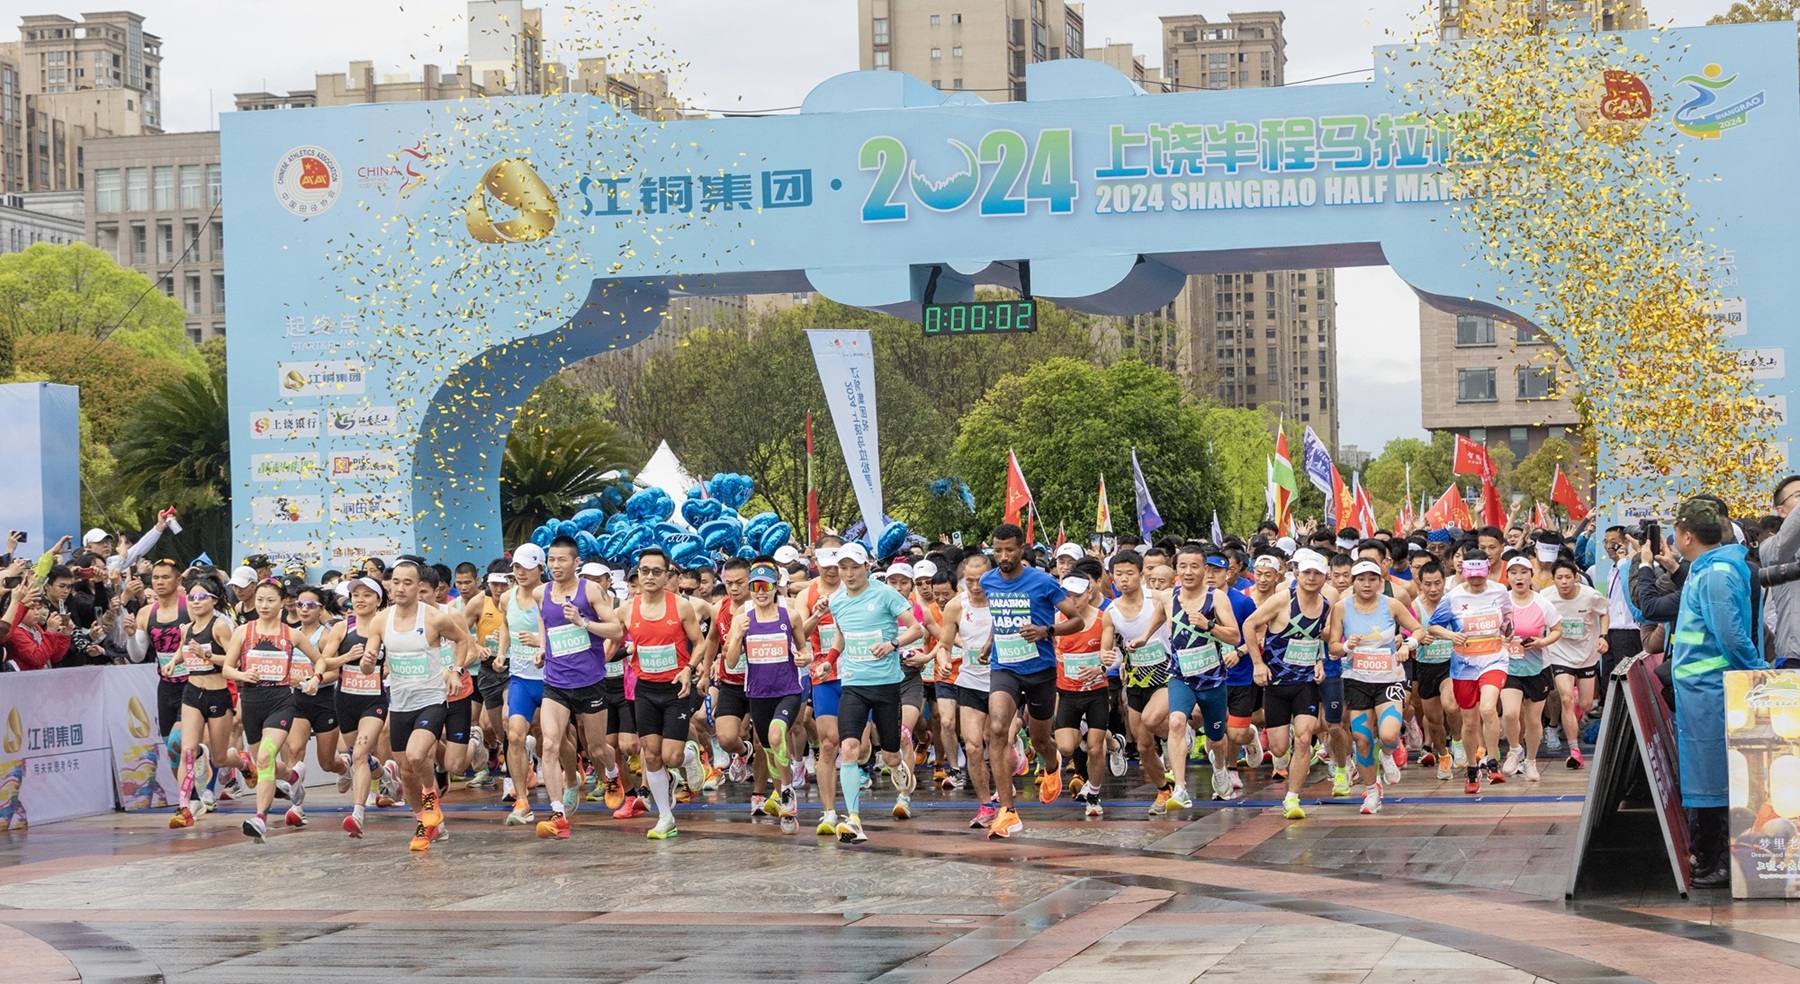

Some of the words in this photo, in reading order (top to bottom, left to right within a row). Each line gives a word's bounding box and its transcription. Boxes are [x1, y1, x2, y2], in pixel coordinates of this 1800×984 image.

[1715, 97, 1761, 120] SHANGRAO
[1719, 116, 1743, 129] 2024
[278, 161, 289, 185] CHINESE
[288, 149, 315, 163] ATHLETICS
[316, 152, 338, 182] ASSOCIATION
[357, 165, 399, 178] CHINA
[858, 127, 1080, 224] 2024
[1095, 182, 1165, 214] 2024
[1171, 174, 1317, 213] SHANGRAO
[1323, 173, 1389, 206] HALF
[1394, 164, 1549, 203] MARTON
[925, 303, 1032, 333] 0:00:02
[285, 313, 360, 338] 起终点
[308, 372, 362, 384] 江铜集团
[272, 417, 317, 430] 上饶银行
[989, 598, 1031, 608] MARATHON
[992, 615, 1032, 629] ABON
[1468, 620, 1497, 632] F1688
[552, 635, 586, 650] M1007
[751, 646, 784, 657] F0788
[849, 645, 871, 655] M17
[1000, 644, 1033, 657] M5017
[1131, 649, 1163, 661] M2513
[1288, 650, 1316, 661] M0303
[1427, 647, 1452, 656] M223
[187, 657, 210, 667] F23
[1183, 655, 1216, 671] M7879
[1356, 659, 1388, 670] F0003
[251, 663, 284, 675] F0820
[391, 664, 425, 675] M0020
[345, 677, 377, 688] F0128
[28, 723, 83, 751] 江铜集团
